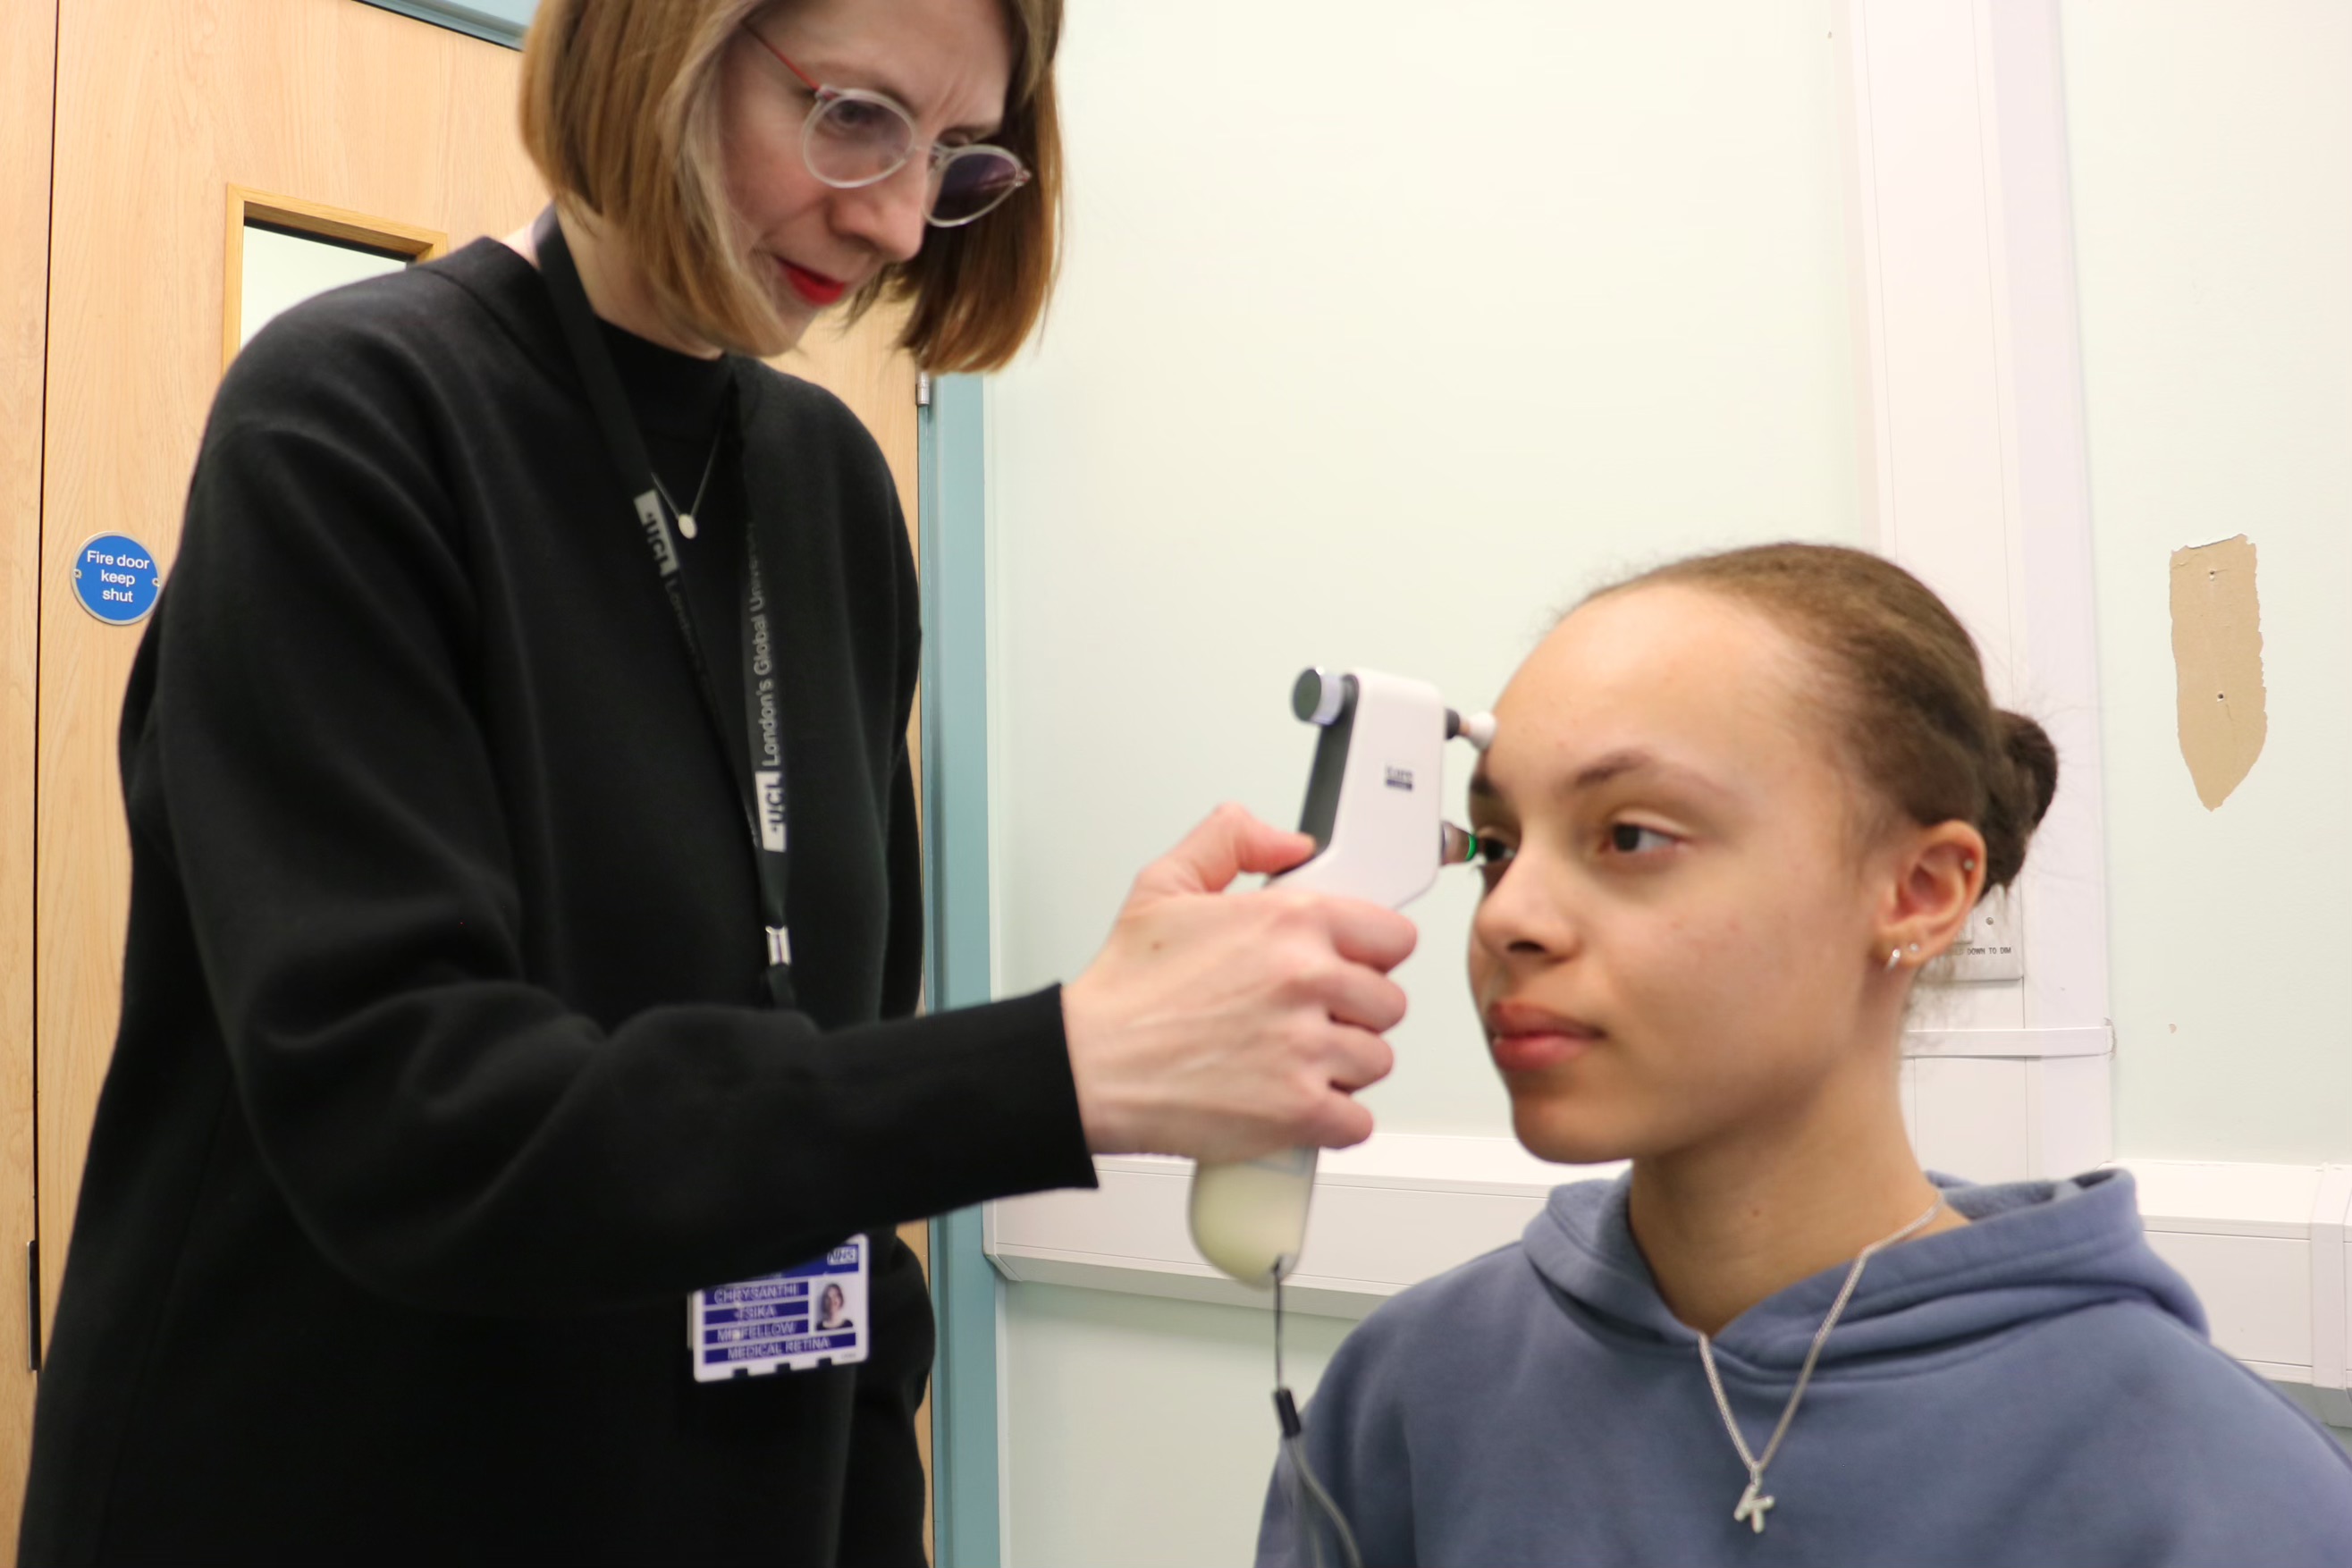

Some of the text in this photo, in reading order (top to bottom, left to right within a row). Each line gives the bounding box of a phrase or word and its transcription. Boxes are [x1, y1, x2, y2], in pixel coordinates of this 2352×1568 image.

[87, 550, 150, 569] Fire door
[100, 569, 136, 587] keep
[102, 588, 134, 603] shut
[750, 613, 773, 676] Global
[757, 679, 781, 767] London's
[764, 775, 787, 824] UCL
[1967, 948, 1985, 956] DOWN
[1988, 947, 1997, 955] TO
[2000, 947, 2011, 955] DIM
[713, 1285, 797, 1304] CHRYSANTHI
[740, 1321, 797, 1340] FELLOW
[727, 1337, 830, 1361] MEDICAL RETINA
